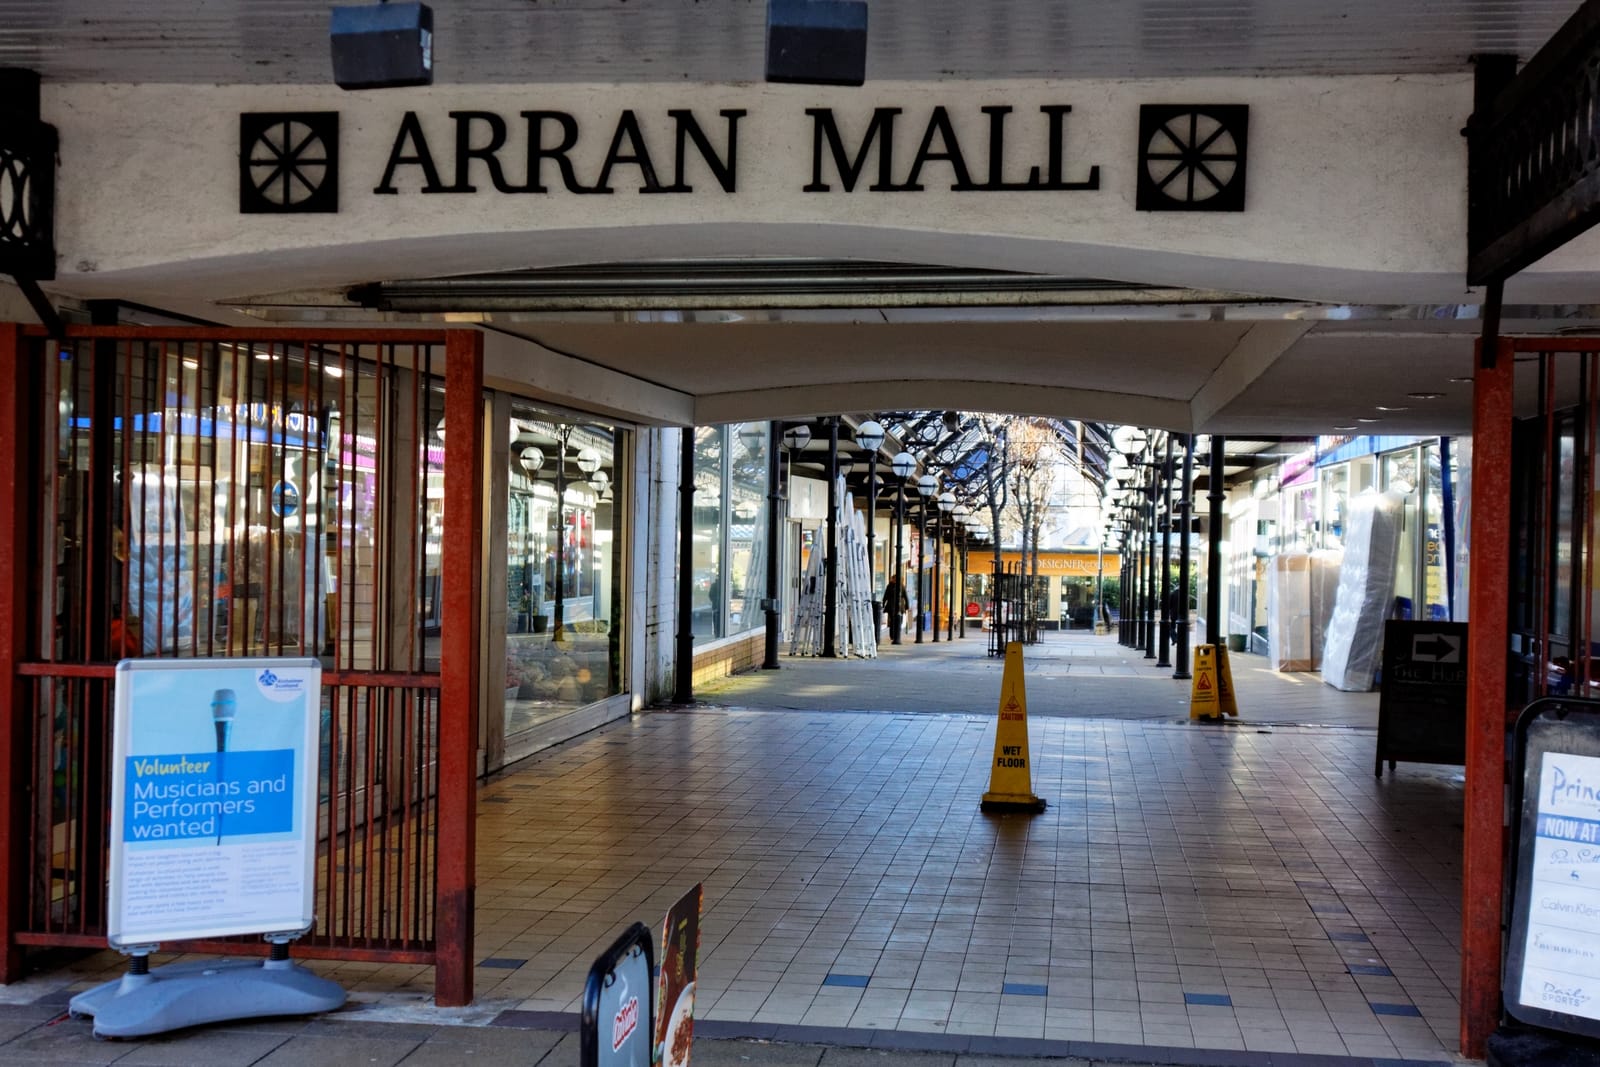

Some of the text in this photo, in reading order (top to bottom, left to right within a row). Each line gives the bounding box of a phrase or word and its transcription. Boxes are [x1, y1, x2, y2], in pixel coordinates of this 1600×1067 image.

[373, 105, 1100, 194] ARRAN MALL
[1001, 712, 1025, 721] CAUTION
[1003, 746, 1022, 756] WET
[133, 755, 211, 778] Volunteer
[997, 757, 1026, 769] FLOOR
[134, 774, 286, 800] Musicians and
[133, 798, 255, 820] Performers
[132, 815, 215, 838] wanted
[1544, 817, 1600, 843] NOW AT
[1542, 993, 1581, 1008] SPORTS
